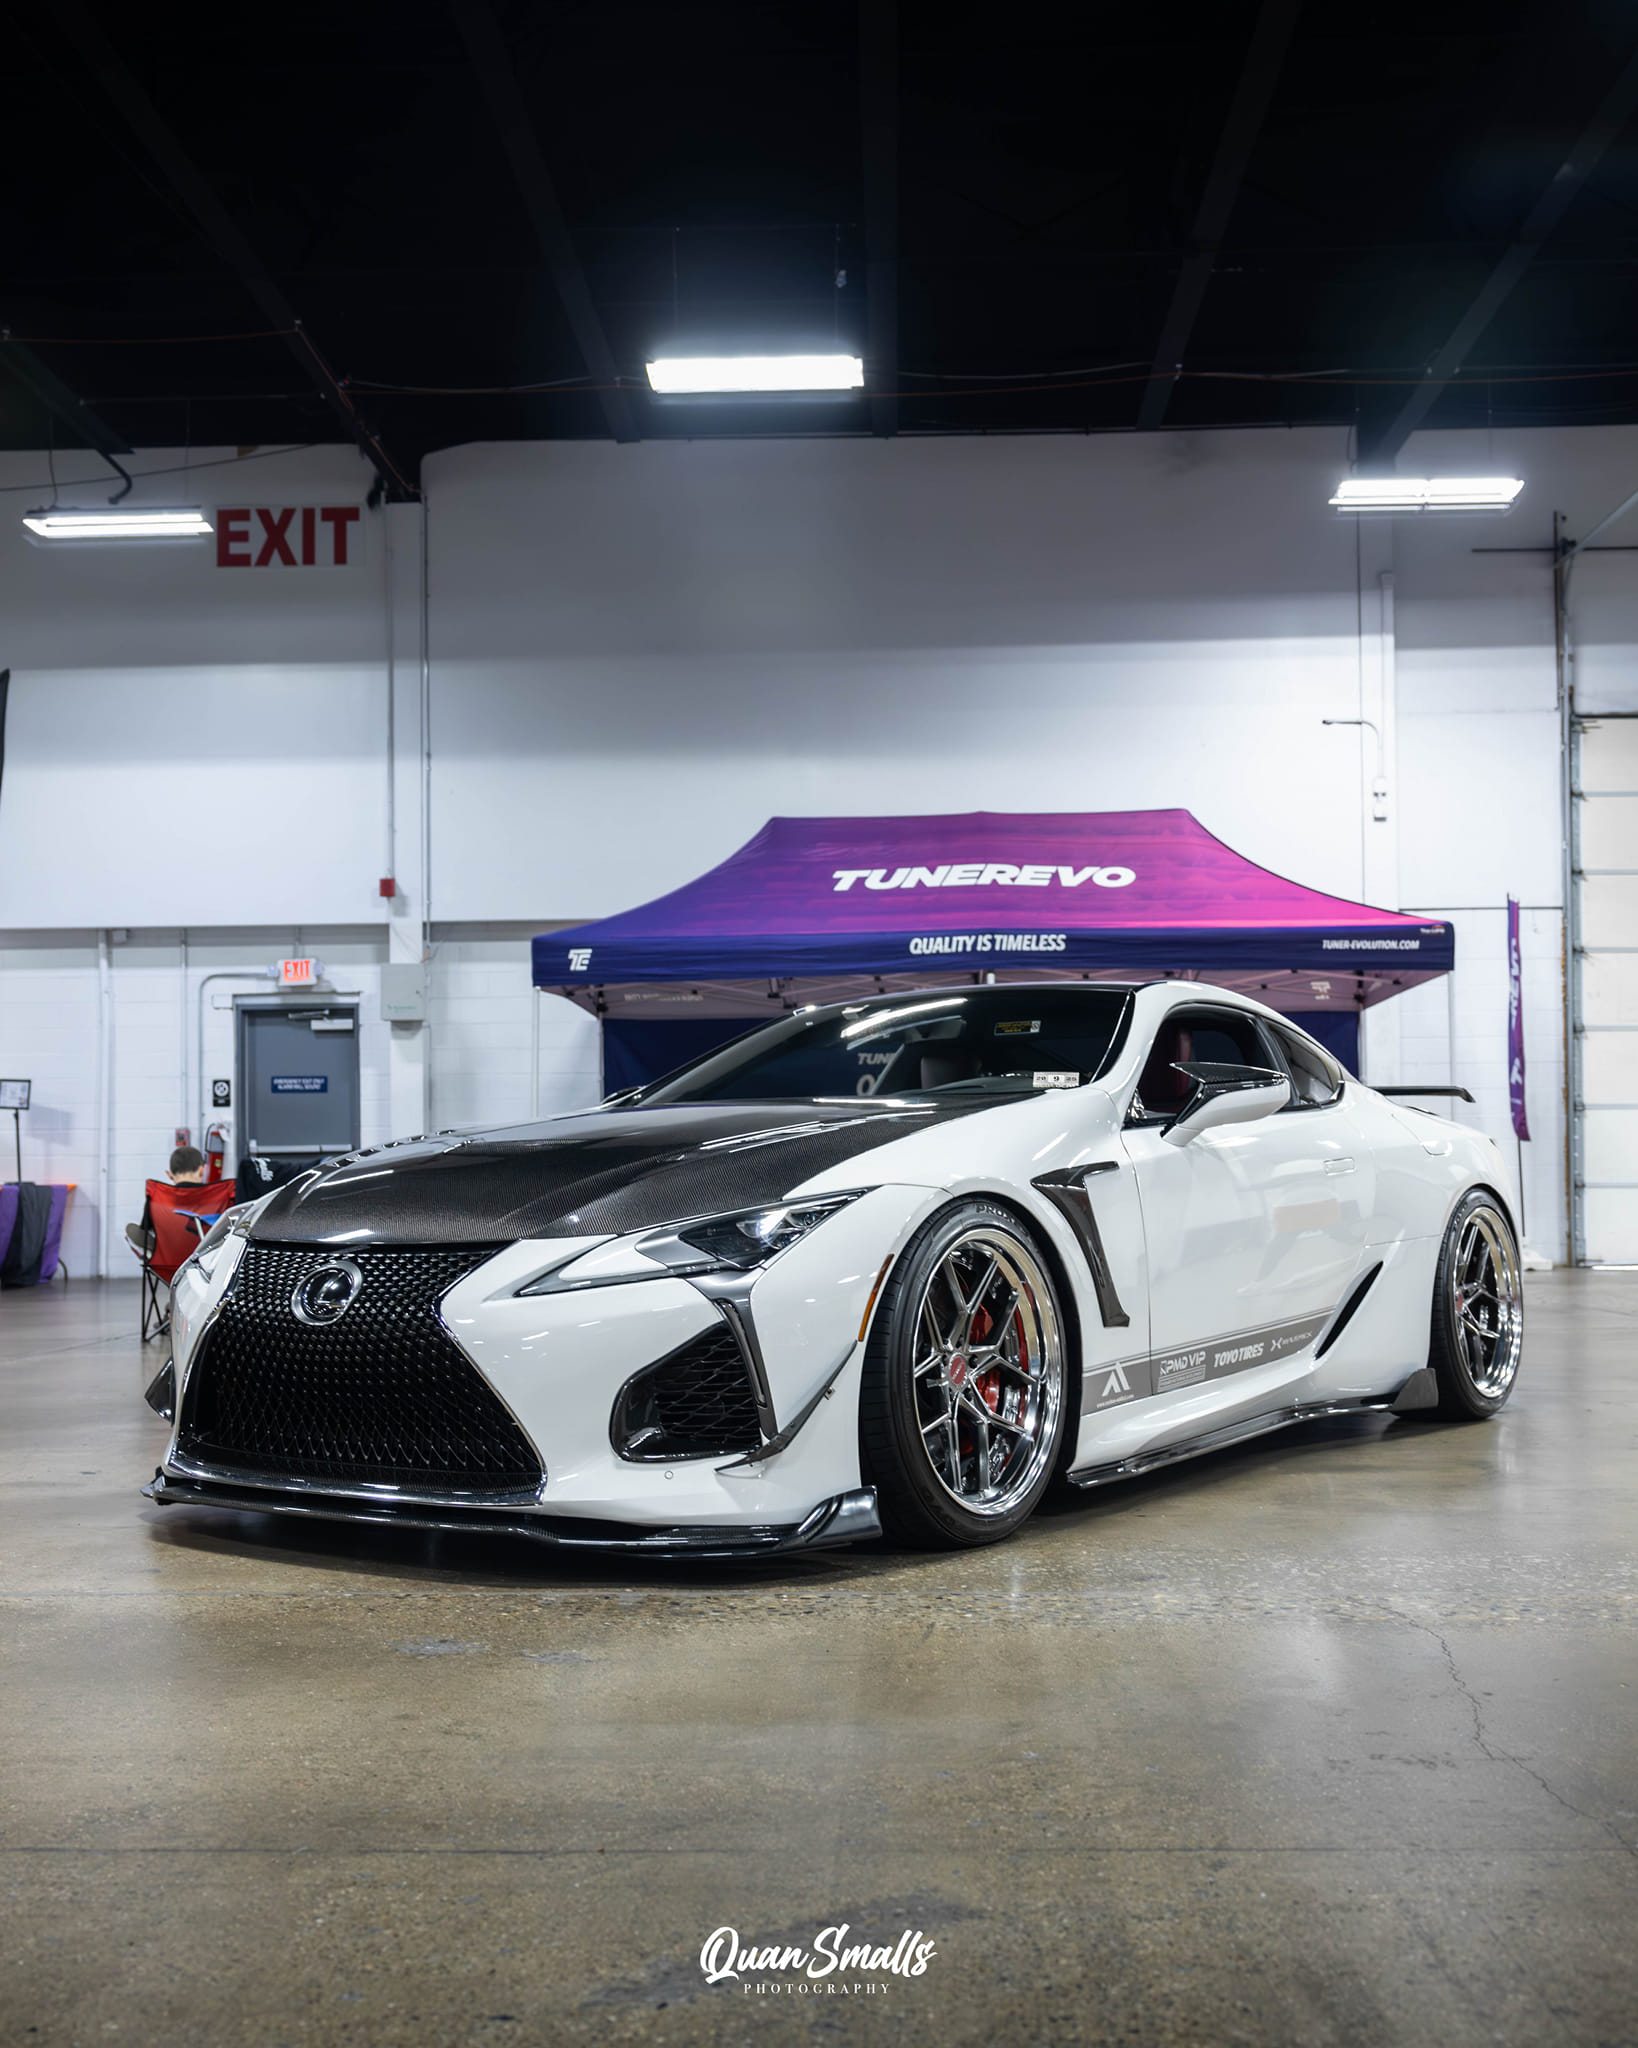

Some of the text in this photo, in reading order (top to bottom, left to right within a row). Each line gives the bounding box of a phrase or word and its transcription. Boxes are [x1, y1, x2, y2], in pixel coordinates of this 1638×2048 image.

[216, 507, 360, 567] EXIT
[832, 864, 1137, 892] TUNEREVO
[909, 933, 1067, 954] QUALITY IS TIMELESS
[1322, 939, 1420, 950] TUNER-EVOLUTION.COM
[283, 959, 311, 981] EXIT
